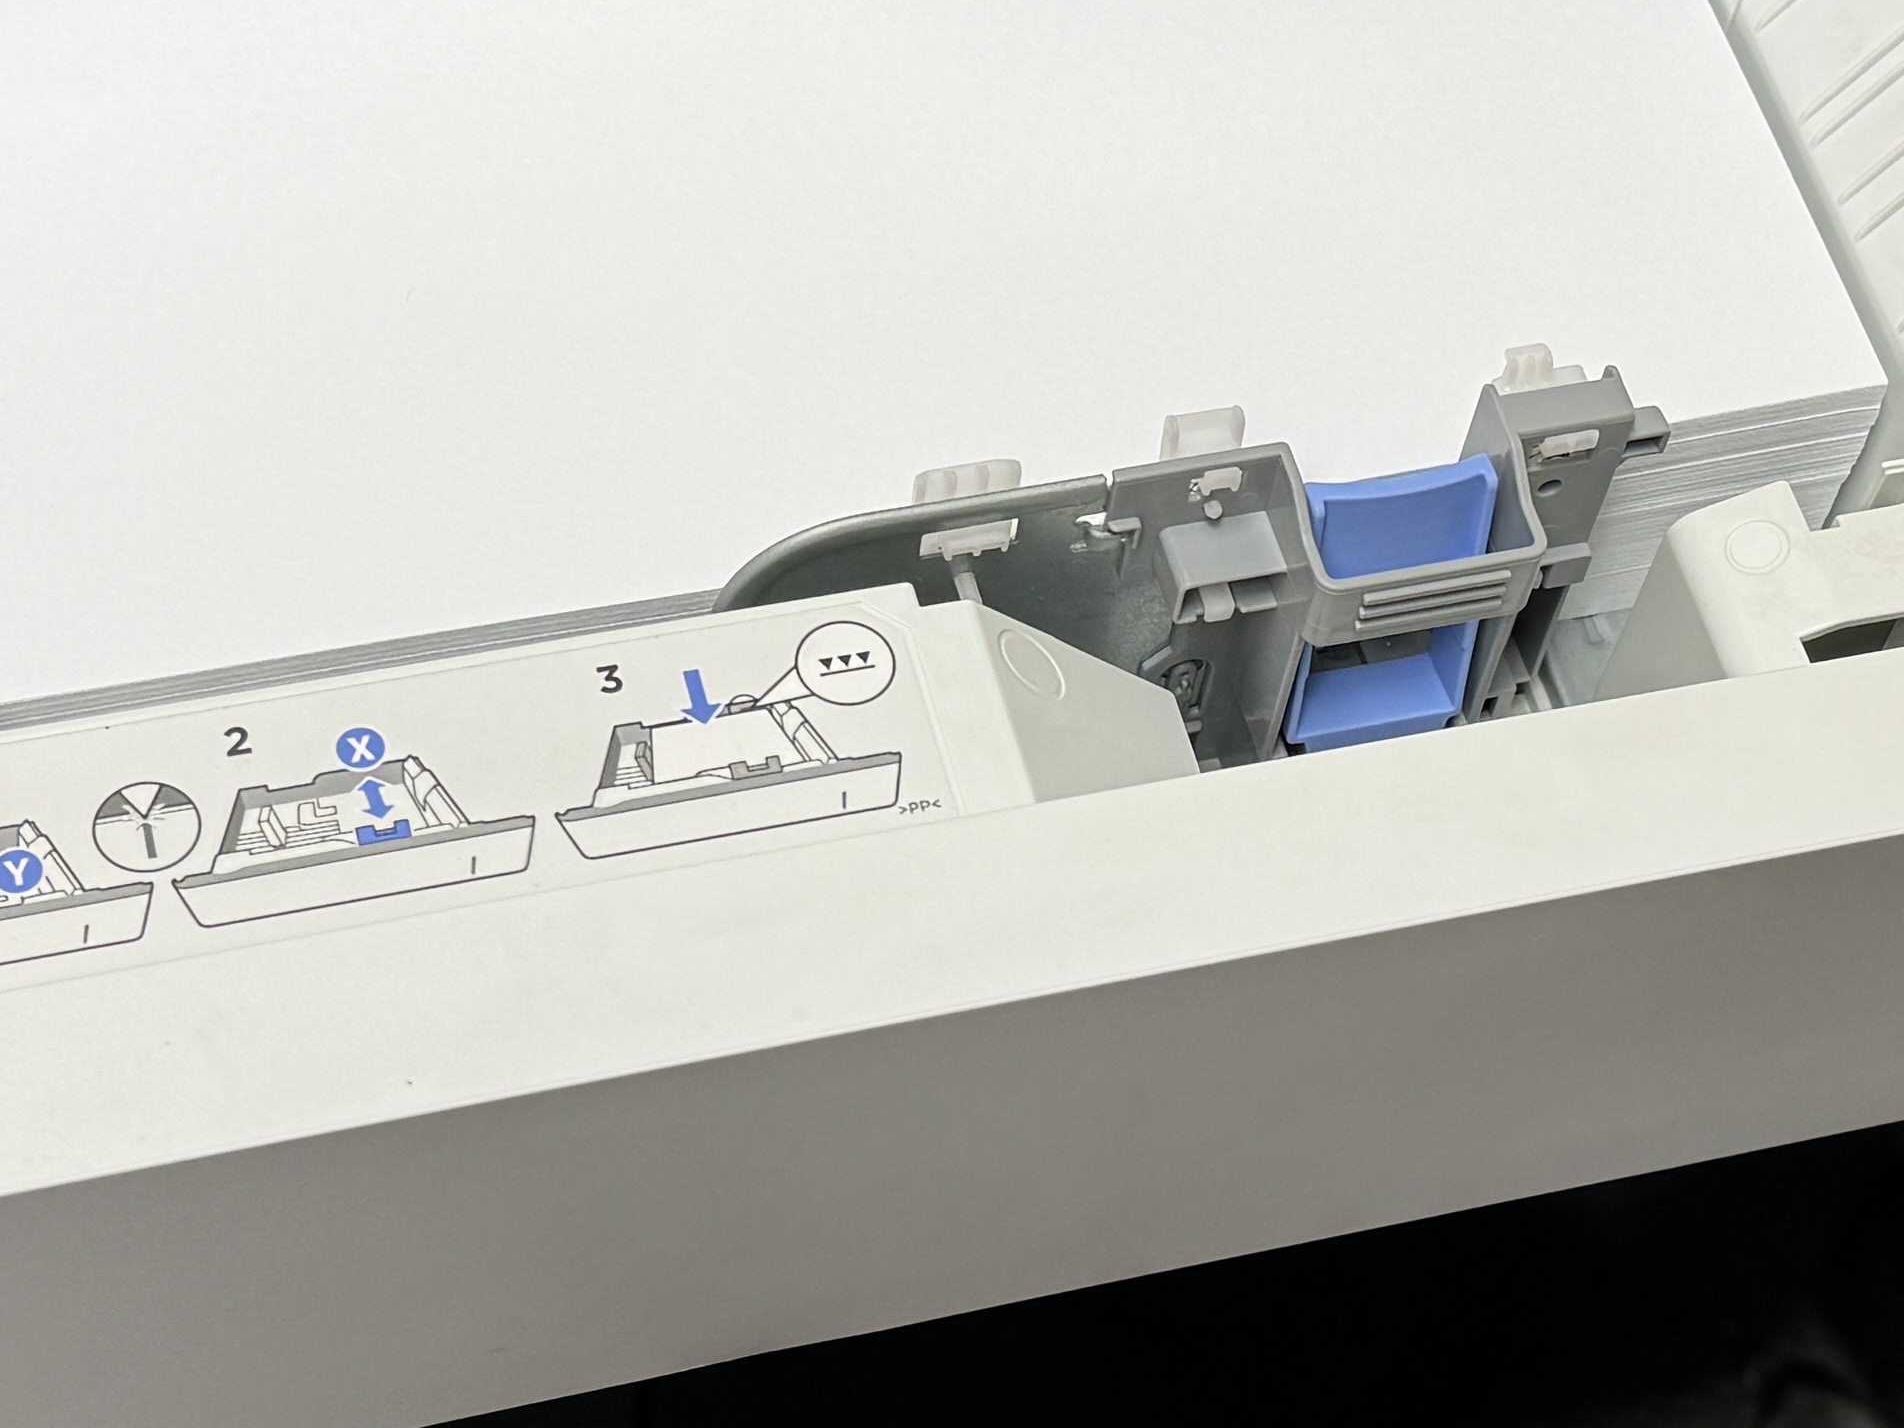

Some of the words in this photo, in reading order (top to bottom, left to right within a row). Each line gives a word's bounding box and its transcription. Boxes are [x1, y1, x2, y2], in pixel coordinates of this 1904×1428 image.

[595, 663, 625, 694] 3
[223, 726, 254, 758] 2
[346, 733, 377, 763] X
[0, 855, 33, 887] Y
